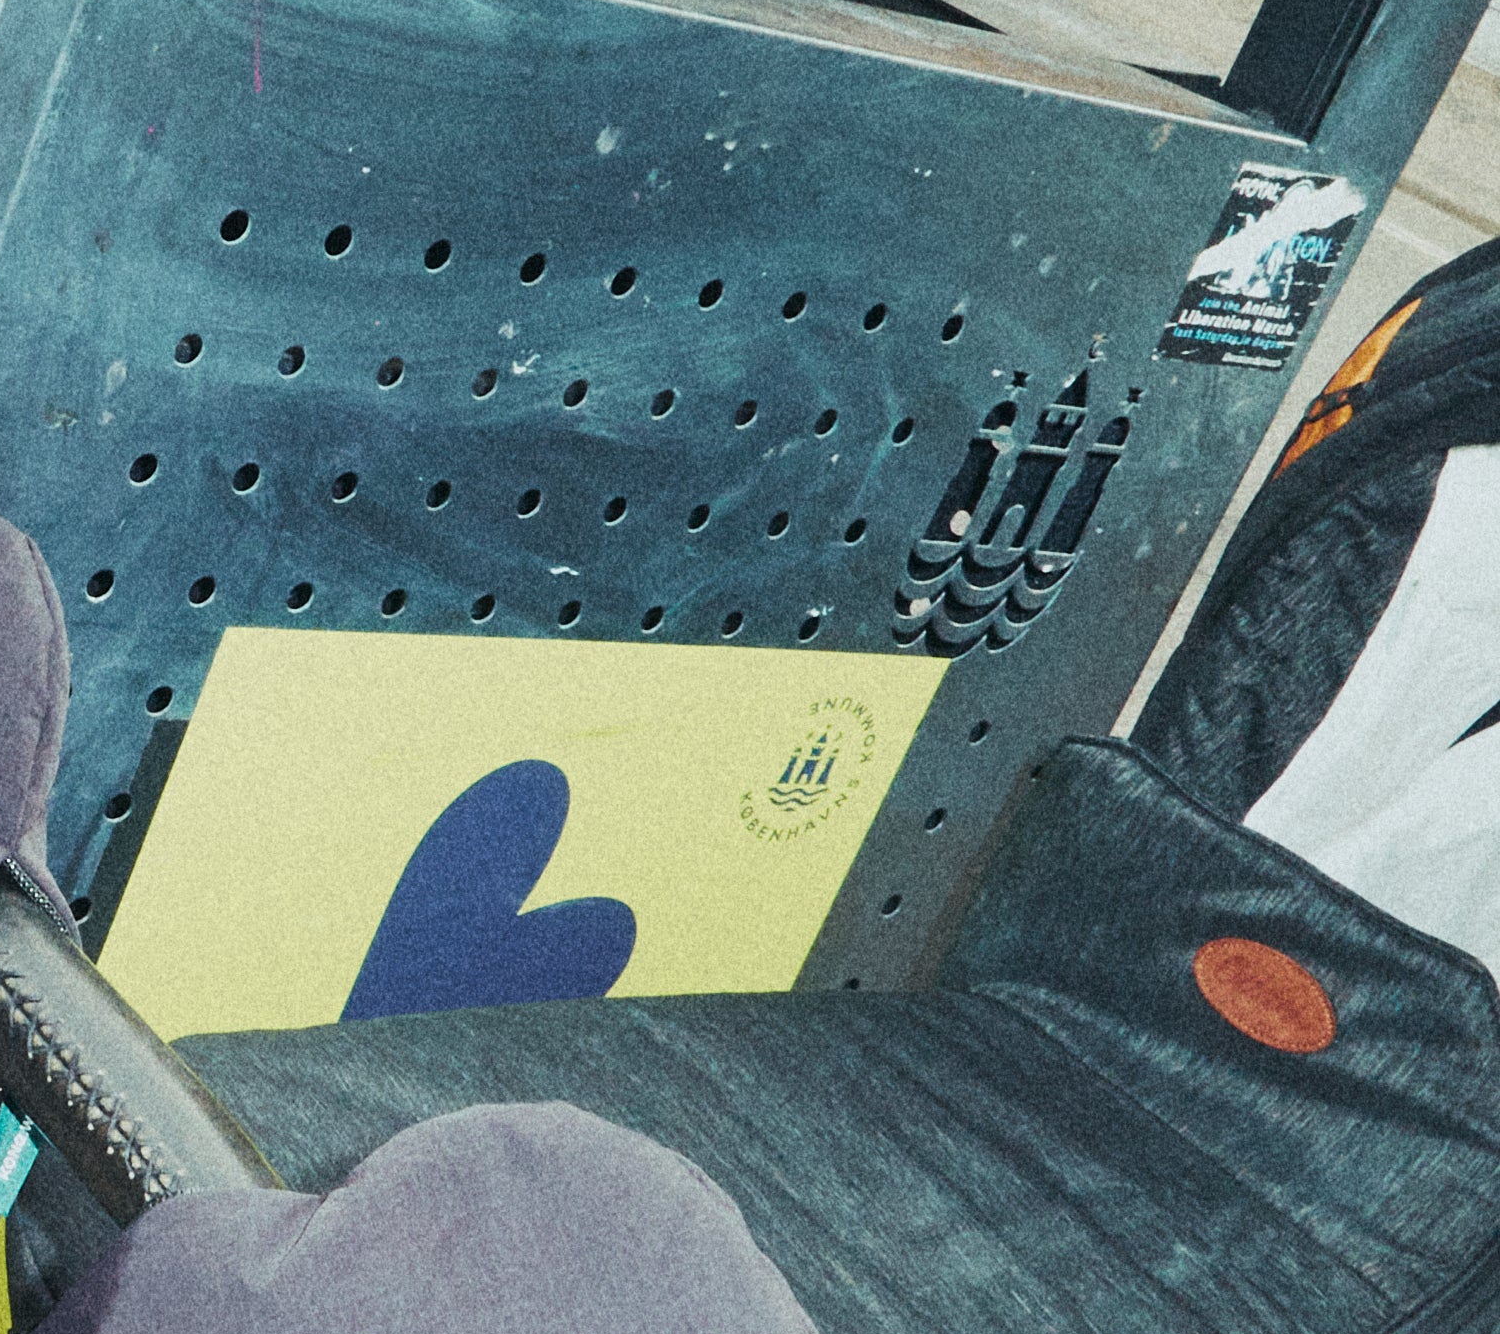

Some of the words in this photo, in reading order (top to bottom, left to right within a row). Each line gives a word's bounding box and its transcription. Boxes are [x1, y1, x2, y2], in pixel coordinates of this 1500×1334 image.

[1235, 177, 1282, 203] TOTAL
[1178, 308, 1251, 330] Liberation
[1252, 320, 1295, 337] March
[1222, 299, 1241, 312] the
[1240, 300, 1291, 319] Animal
[739, 778, 860, 842] KØBENHAVNS
[809, 697, 876, 764] KOMMUNE
